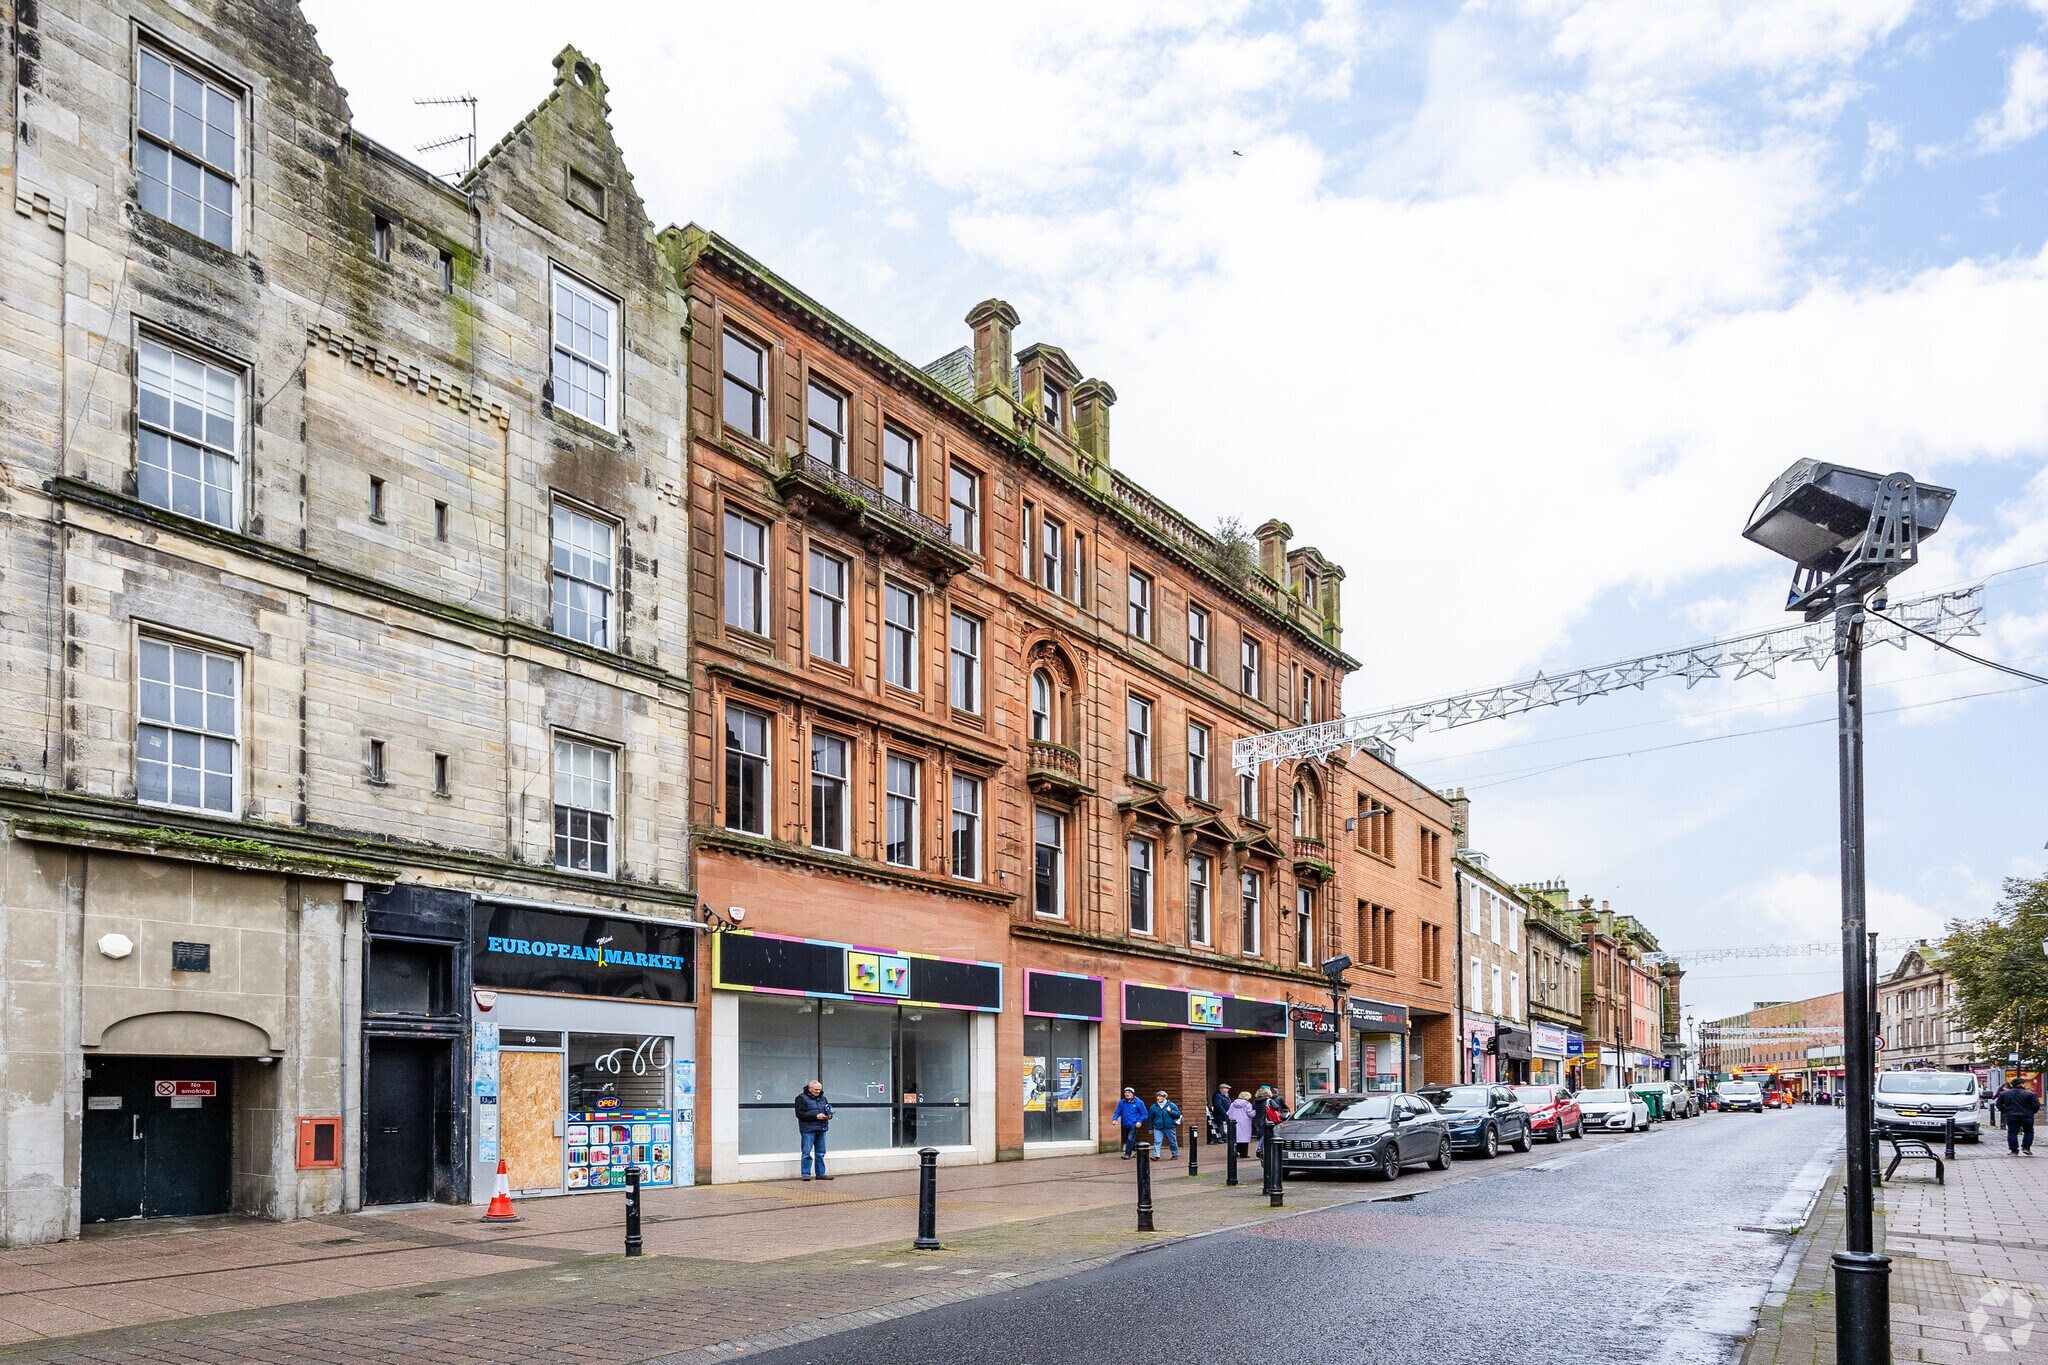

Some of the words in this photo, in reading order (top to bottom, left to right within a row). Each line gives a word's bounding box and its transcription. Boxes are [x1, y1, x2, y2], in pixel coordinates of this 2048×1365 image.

[488, 936, 600, 962] EUROPEAN
[604, 949, 684, 970] MARKET
[856, 964, 876, 985] 15
[887, 967, 906, 988] 17
[525, 1035, 536, 1043] 86
[598, 1099, 618, 1107] OPEN
